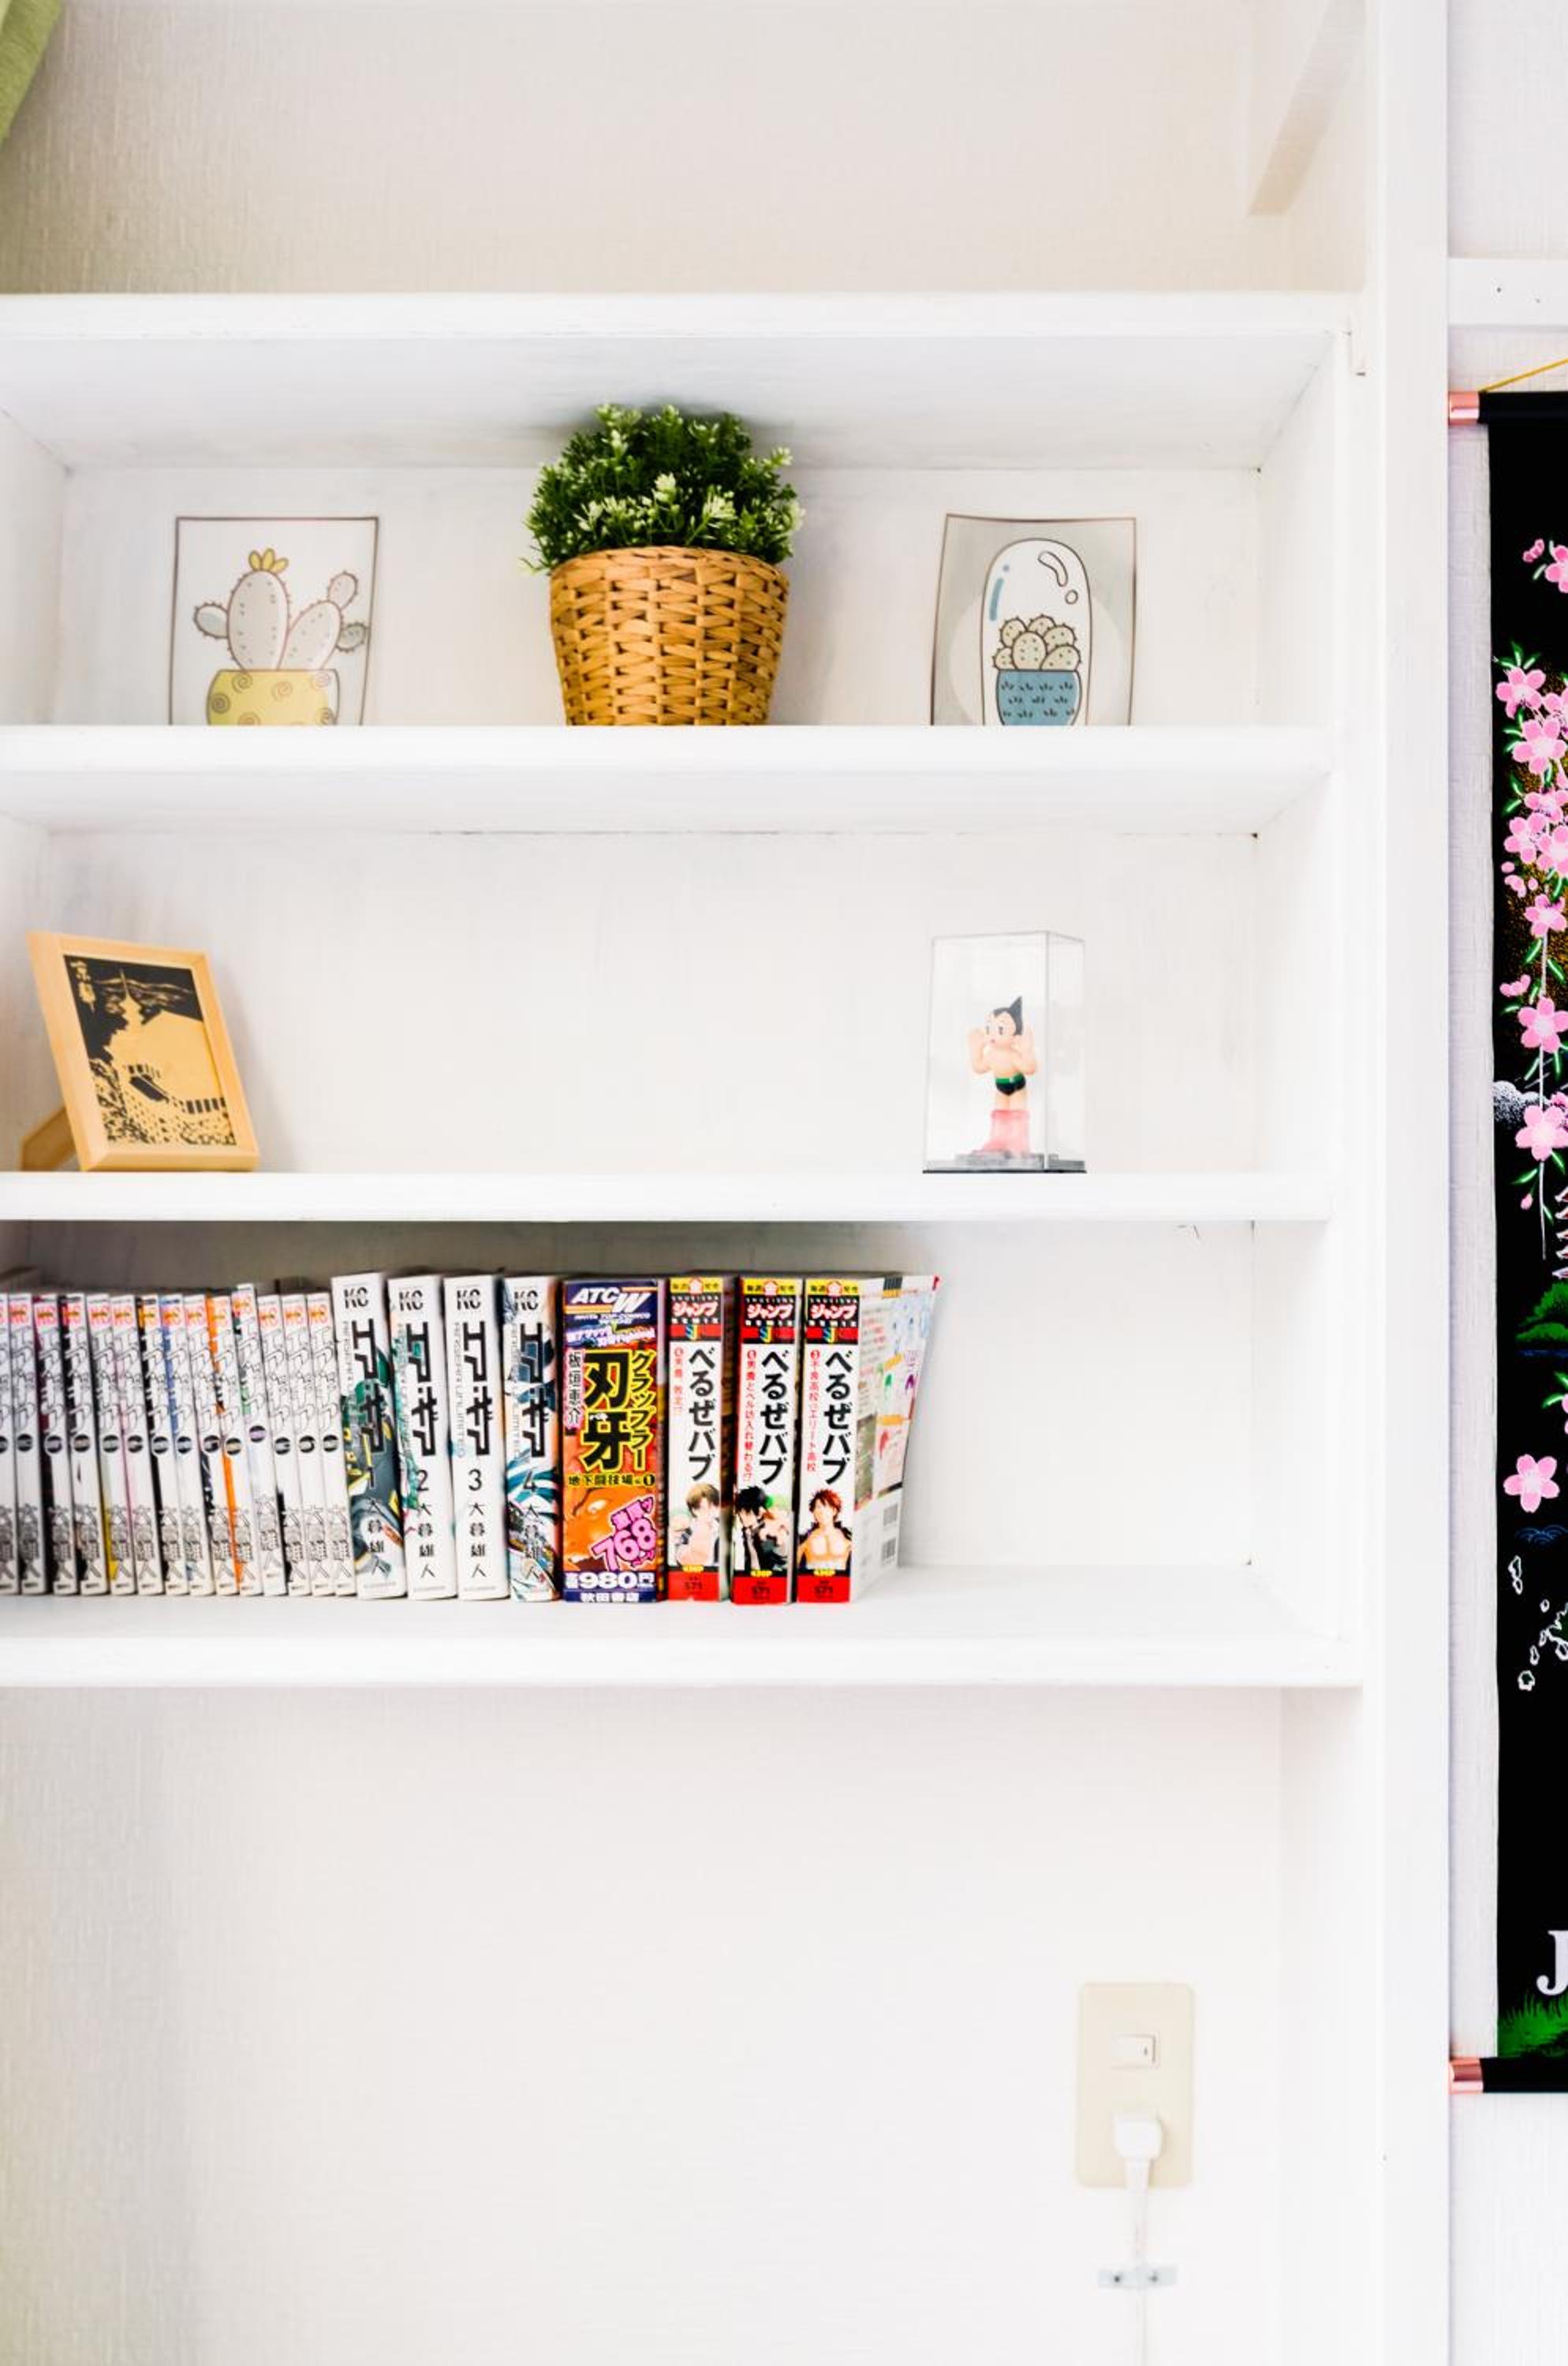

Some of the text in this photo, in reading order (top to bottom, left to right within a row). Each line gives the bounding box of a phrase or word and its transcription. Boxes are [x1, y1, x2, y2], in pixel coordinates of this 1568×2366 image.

[398, 1289, 424, 1311] KC
[456, 1289, 481, 1310] KC
[689, 1347, 716, 1481] べるぜバブ
[760, 1349, 790, 1484] べるぜバブ
[822, 1349, 853, 1484] べるぜバブ
[416, 1469, 429, 1491] 2
[469, 1469, 483, 1491] 3
[523, 1470, 537, 1492] 4
